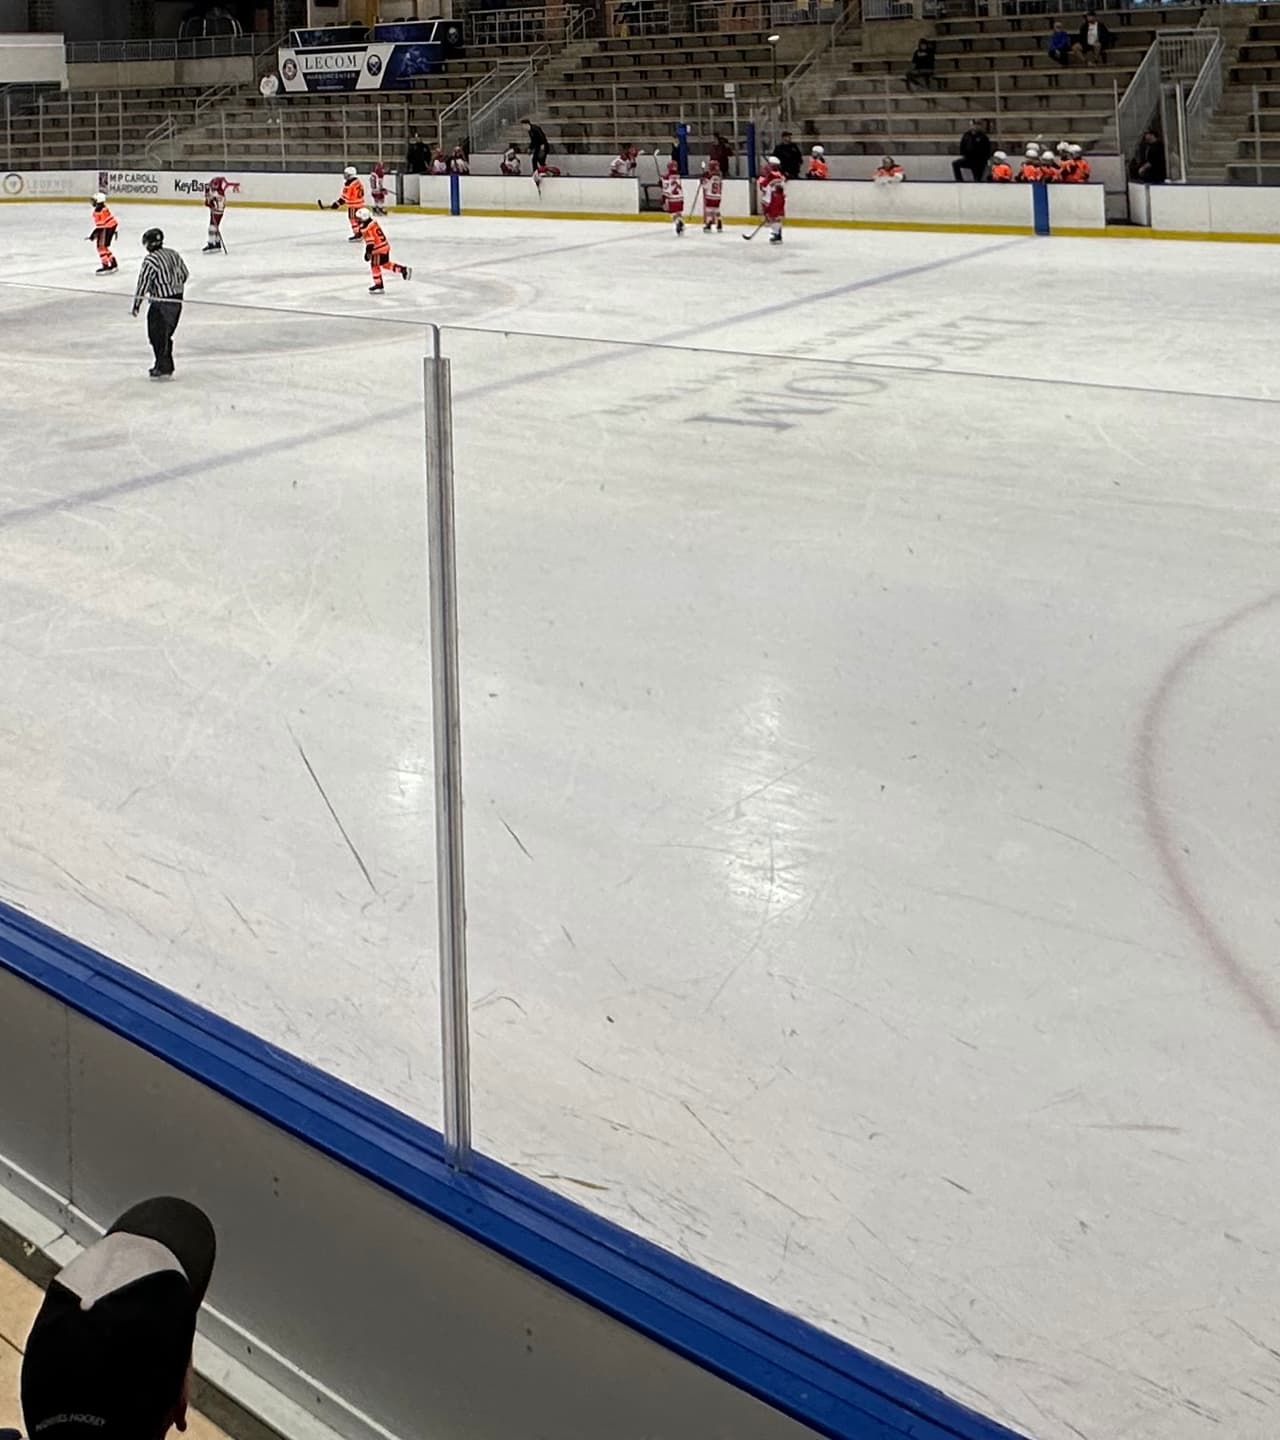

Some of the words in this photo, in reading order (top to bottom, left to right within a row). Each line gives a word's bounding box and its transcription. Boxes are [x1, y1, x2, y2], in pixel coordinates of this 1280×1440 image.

[305, 54, 357, 70] LECOM
[110, 173, 117, 182] M
[118, 173, 124, 182] P
[110, 183, 159, 194] HARDWOOD
